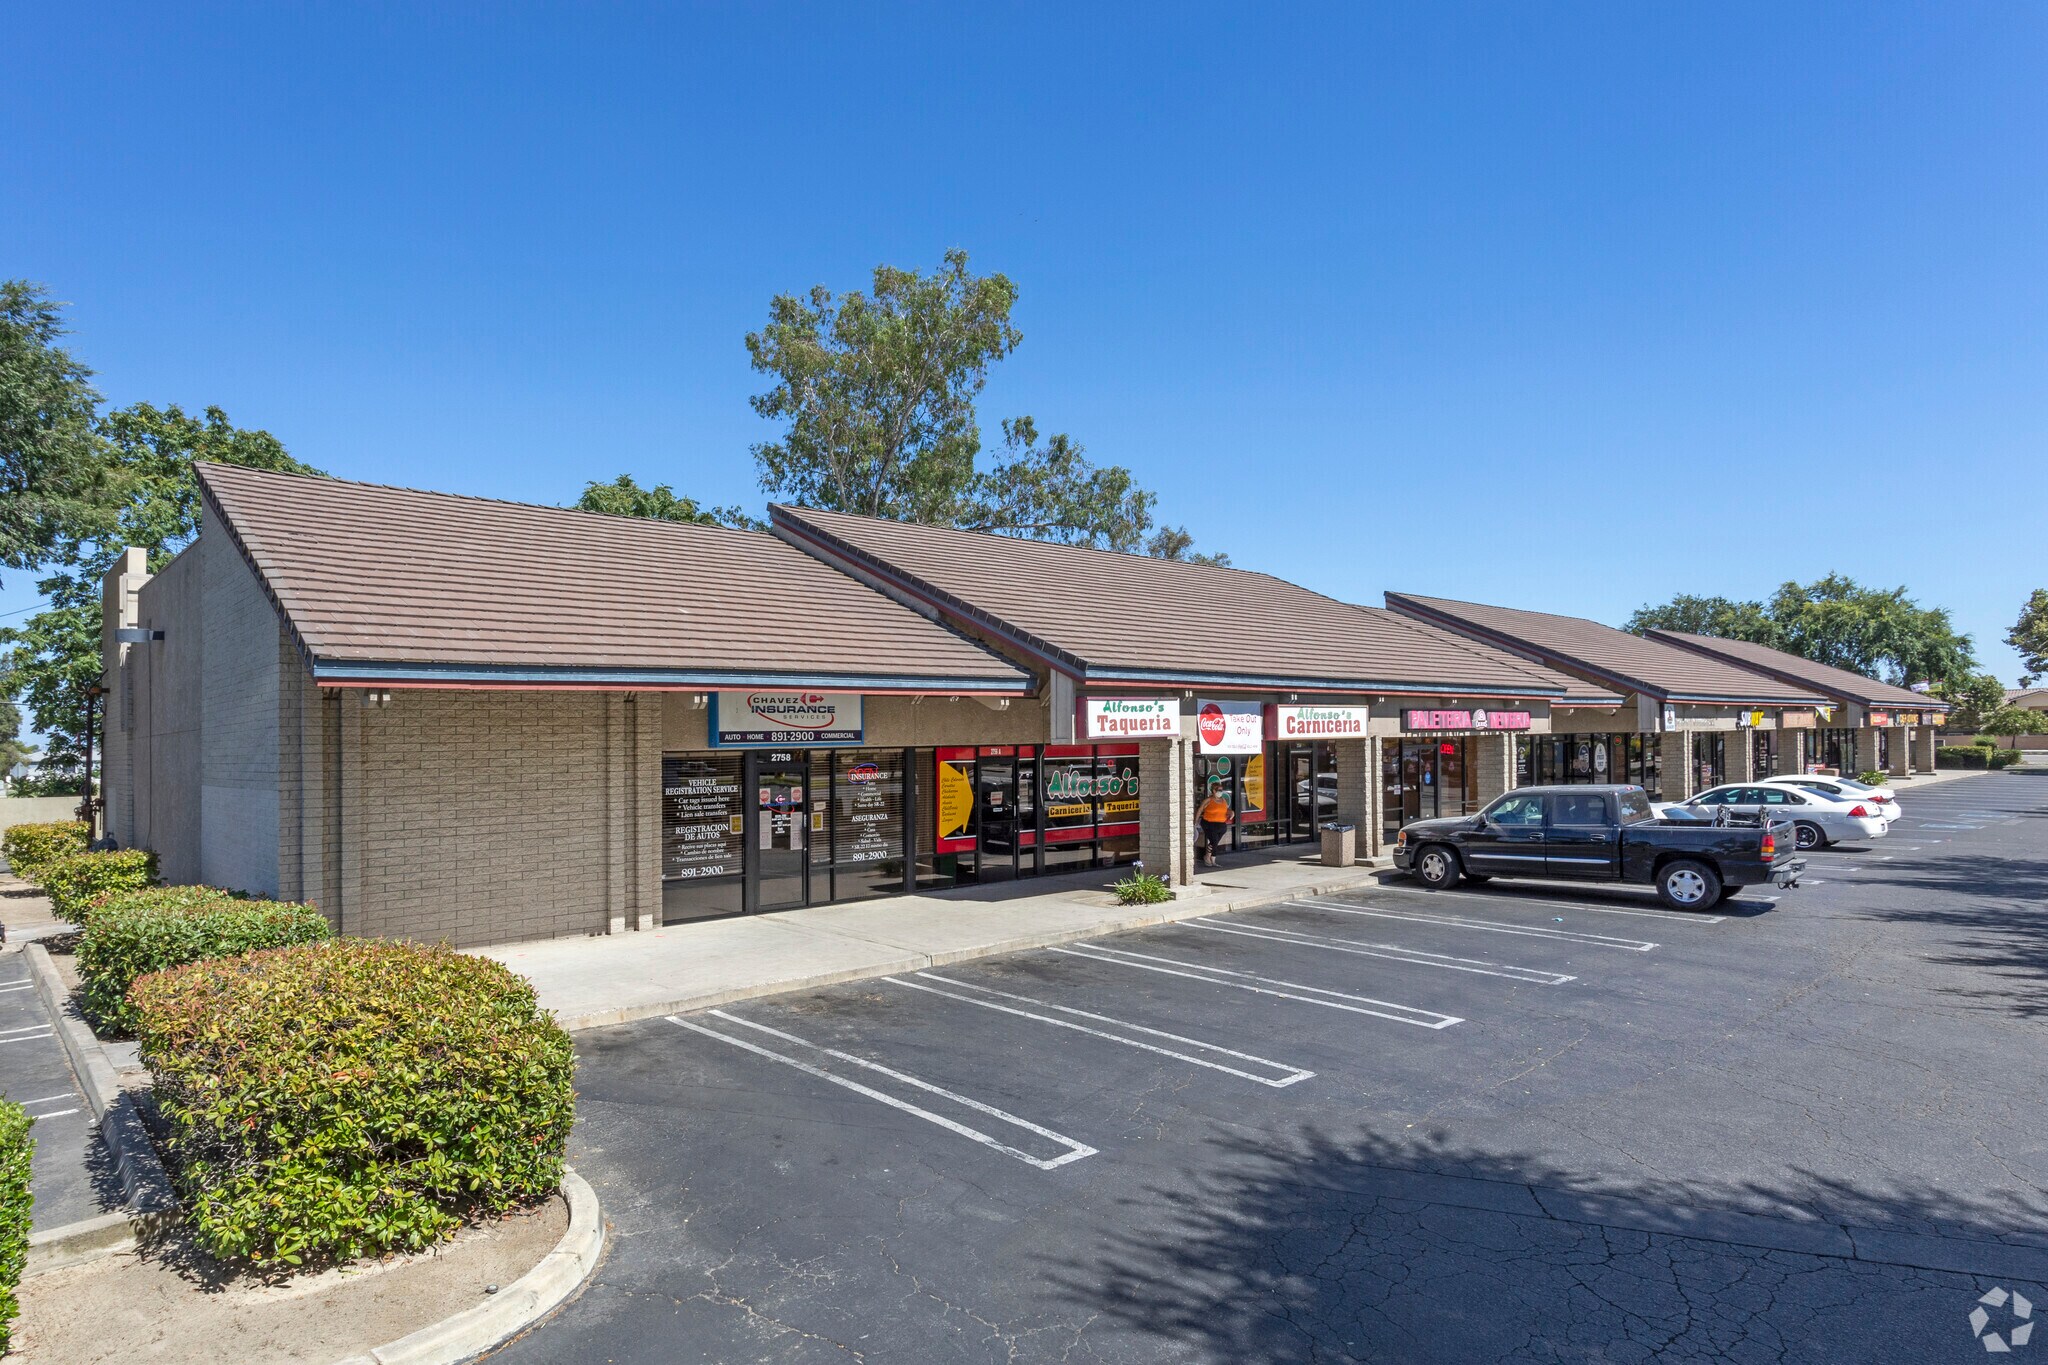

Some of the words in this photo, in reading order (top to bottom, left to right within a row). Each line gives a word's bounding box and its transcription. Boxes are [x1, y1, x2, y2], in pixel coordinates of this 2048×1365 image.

[751, 705, 836, 714] INSURANCE
[1103, 700, 1165, 713] Alfonso's
[1229, 713, 1245, 724] Take
[1245, 714, 1257, 724] Out
[1297, 707, 1352, 720] Alfonso's
[1096, 714, 1171, 735] Taqueria
[1286, 716, 1361, 734] Carniceria
[724, 733, 741, 741] AUTO
[771, 731, 815, 741] 891-2900
[1236, 726, 1251, 737] Only
[771, 753, 791, 762] 2758
[851, 772, 888, 781] INSURANCE
[688, 778, 717, 787] VEHICLE
[1047, 767, 1139, 800] Alfonso's
[665, 786, 712, 796] REGISTRATION
[713, 785, 739, 794] SERVICE
[1049, 805, 1091, 816] Carniceria
[1106, 801, 1139, 811] Taqueria
[705, 809, 728, 817] transfers
[851, 813, 889, 822] ASEGURANZA
[675, 823, 729, 834] REGISTRACION
[684, 833, 696, 841] DE
[696, 831, 720, 840] AUTOS
[852, 850, 887, 862] 891-2900
[681, 865, 724, 878] 891-2900
